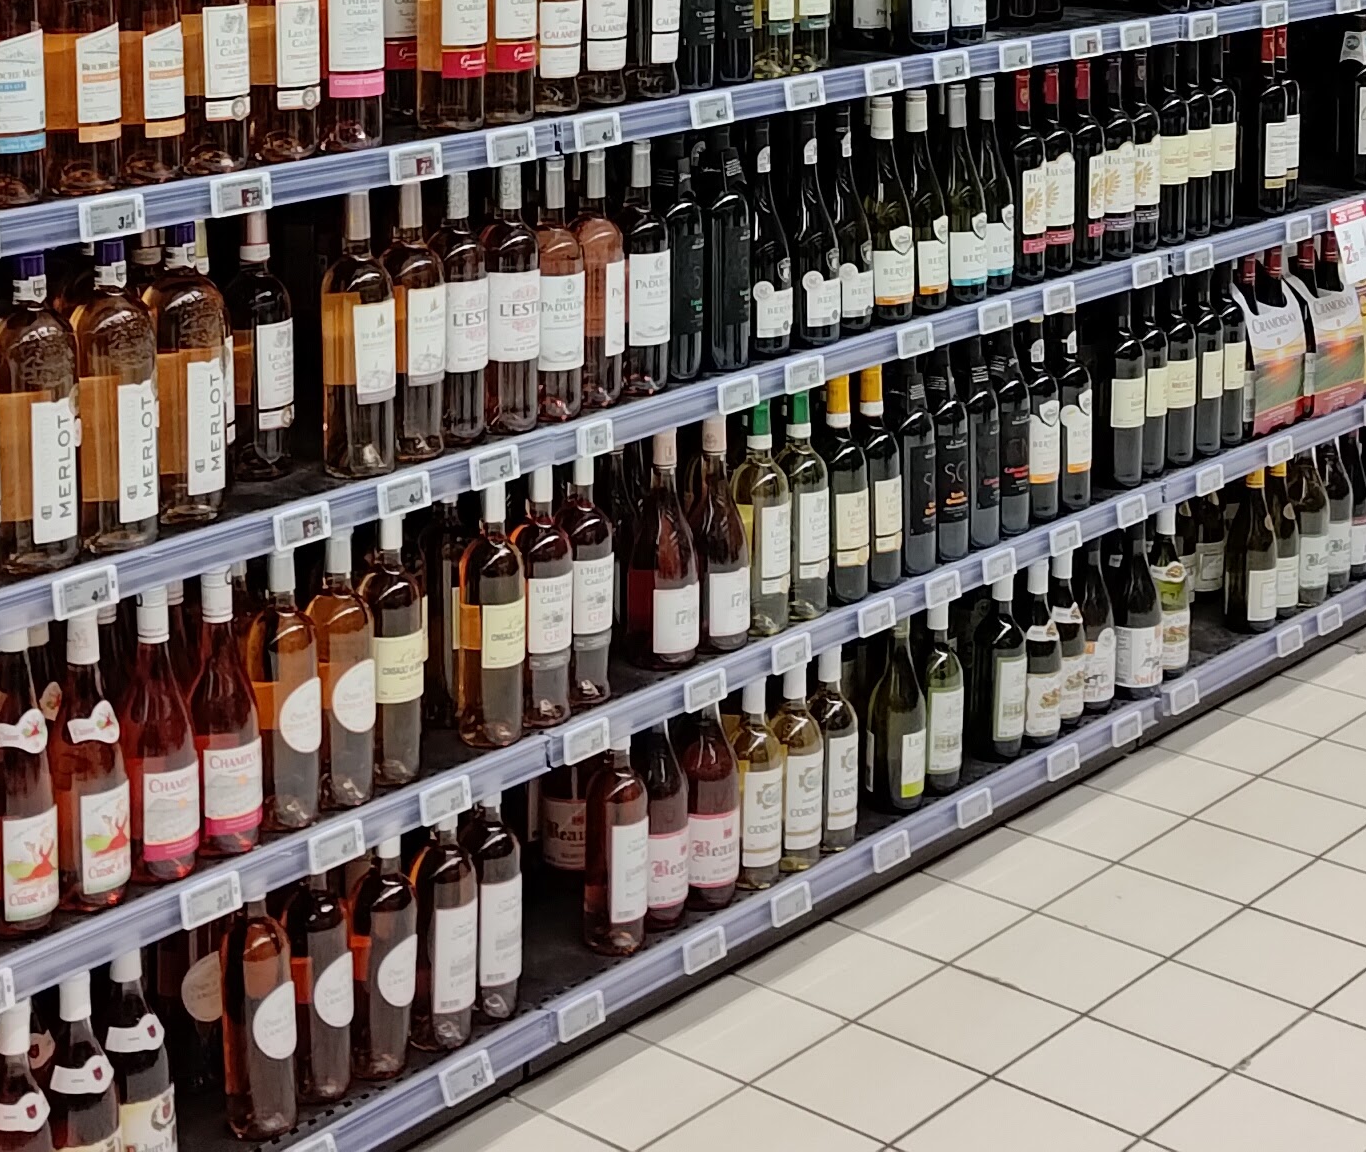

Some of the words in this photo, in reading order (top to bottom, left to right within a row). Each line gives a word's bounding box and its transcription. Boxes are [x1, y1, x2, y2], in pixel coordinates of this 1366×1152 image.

[56, 415, 72, 519] MERLOT
[141, 396, 155, 499] MERLOT
[210, 373, 224, 471] MERLOT
